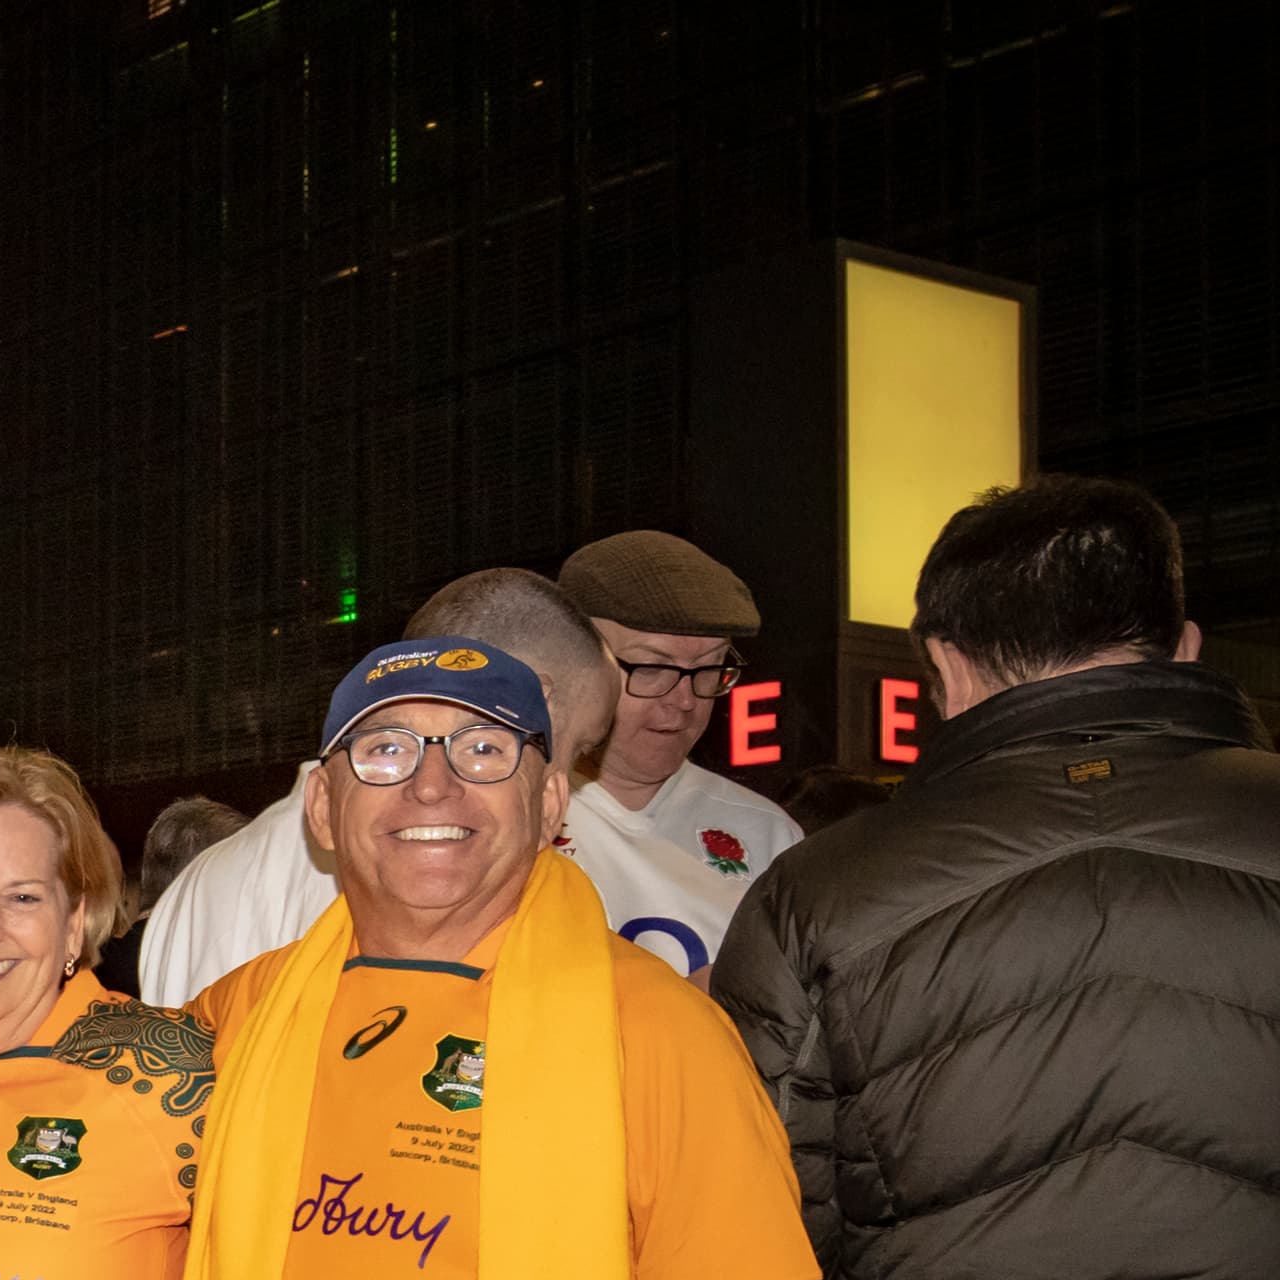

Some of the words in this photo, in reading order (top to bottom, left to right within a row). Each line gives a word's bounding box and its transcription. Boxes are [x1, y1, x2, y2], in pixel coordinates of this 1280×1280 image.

[365, 656, 436, 685] RUGBY
[730, 680, 782, 767] E
[879, 678, 920, 764] E
[396, 1121, 442, 1135] Australia
[411, 1136, 419, 1145] 9
[421, 1138, 444, 1150] July
[448, 1142, 476, 1154] 2022
[7, 1202, 28, 1212] July
[31, 1203, 57, 1215] 2022
[37, 1192, 78, 1207] England
[24, 1215, 71, 1231] Brisbane
[292, 1172, 452, 1270] dbury
